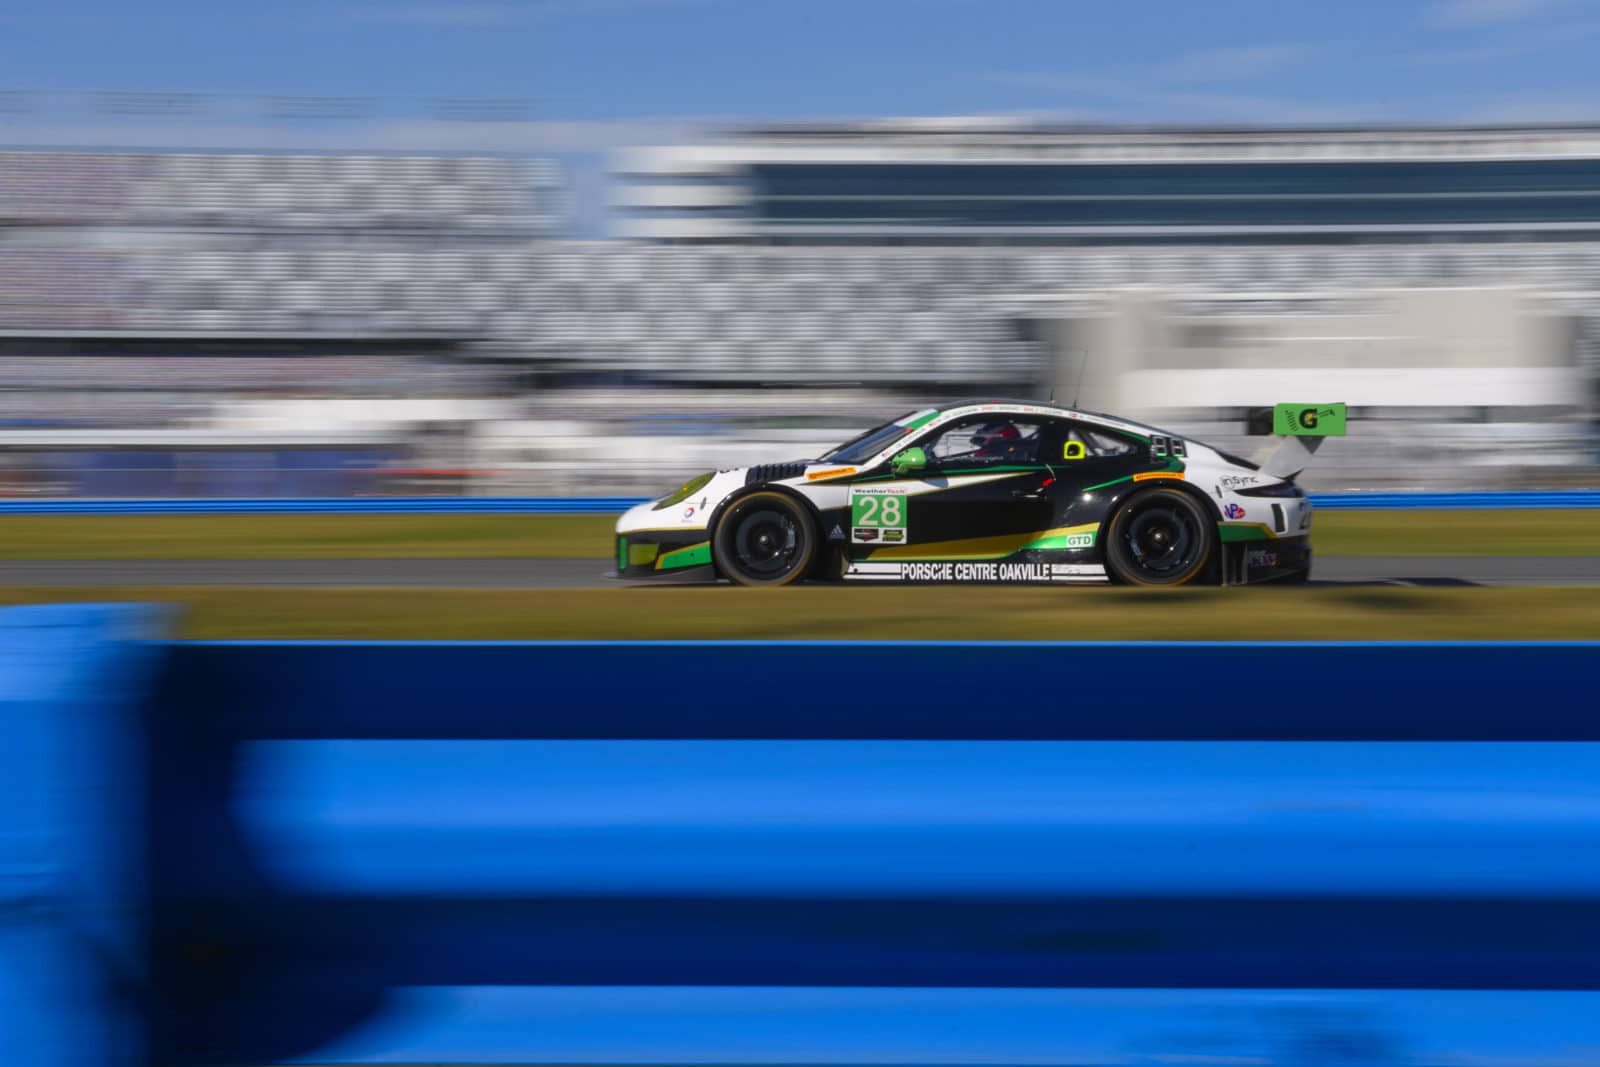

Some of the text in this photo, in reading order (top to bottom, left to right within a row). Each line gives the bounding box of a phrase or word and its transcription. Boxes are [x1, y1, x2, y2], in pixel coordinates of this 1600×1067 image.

[1299, 408, 1318, 429] G
[859, 496, 901, 526] 28
[1068, 535, 1091, 546] GTD
[901, 563, 1050, 580] PORSCHE CENTRE OAKVILLE
